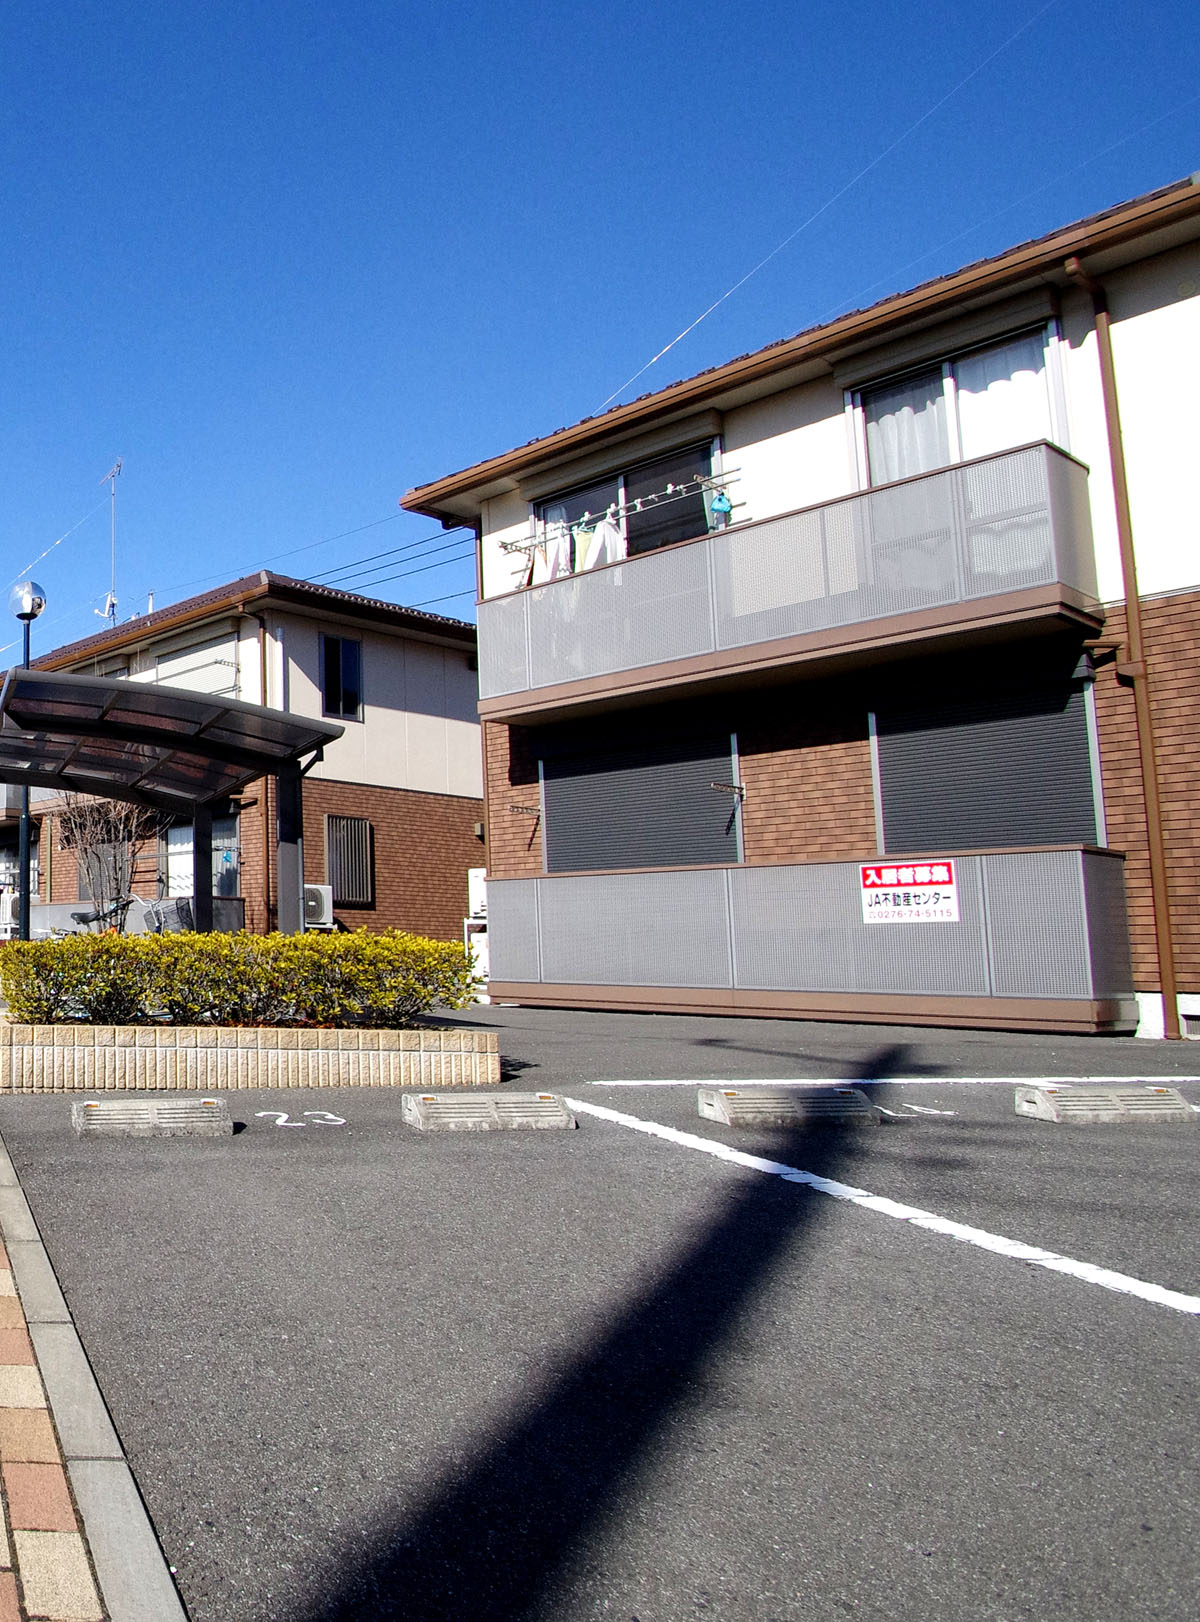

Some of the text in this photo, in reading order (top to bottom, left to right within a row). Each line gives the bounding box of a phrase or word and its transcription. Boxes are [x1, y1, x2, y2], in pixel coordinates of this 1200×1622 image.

[865, 865, 950, 885] 入居者募集
[868, 892, 951, 907] JA不動産センター
[255, 1111, 346, 1126] 23
